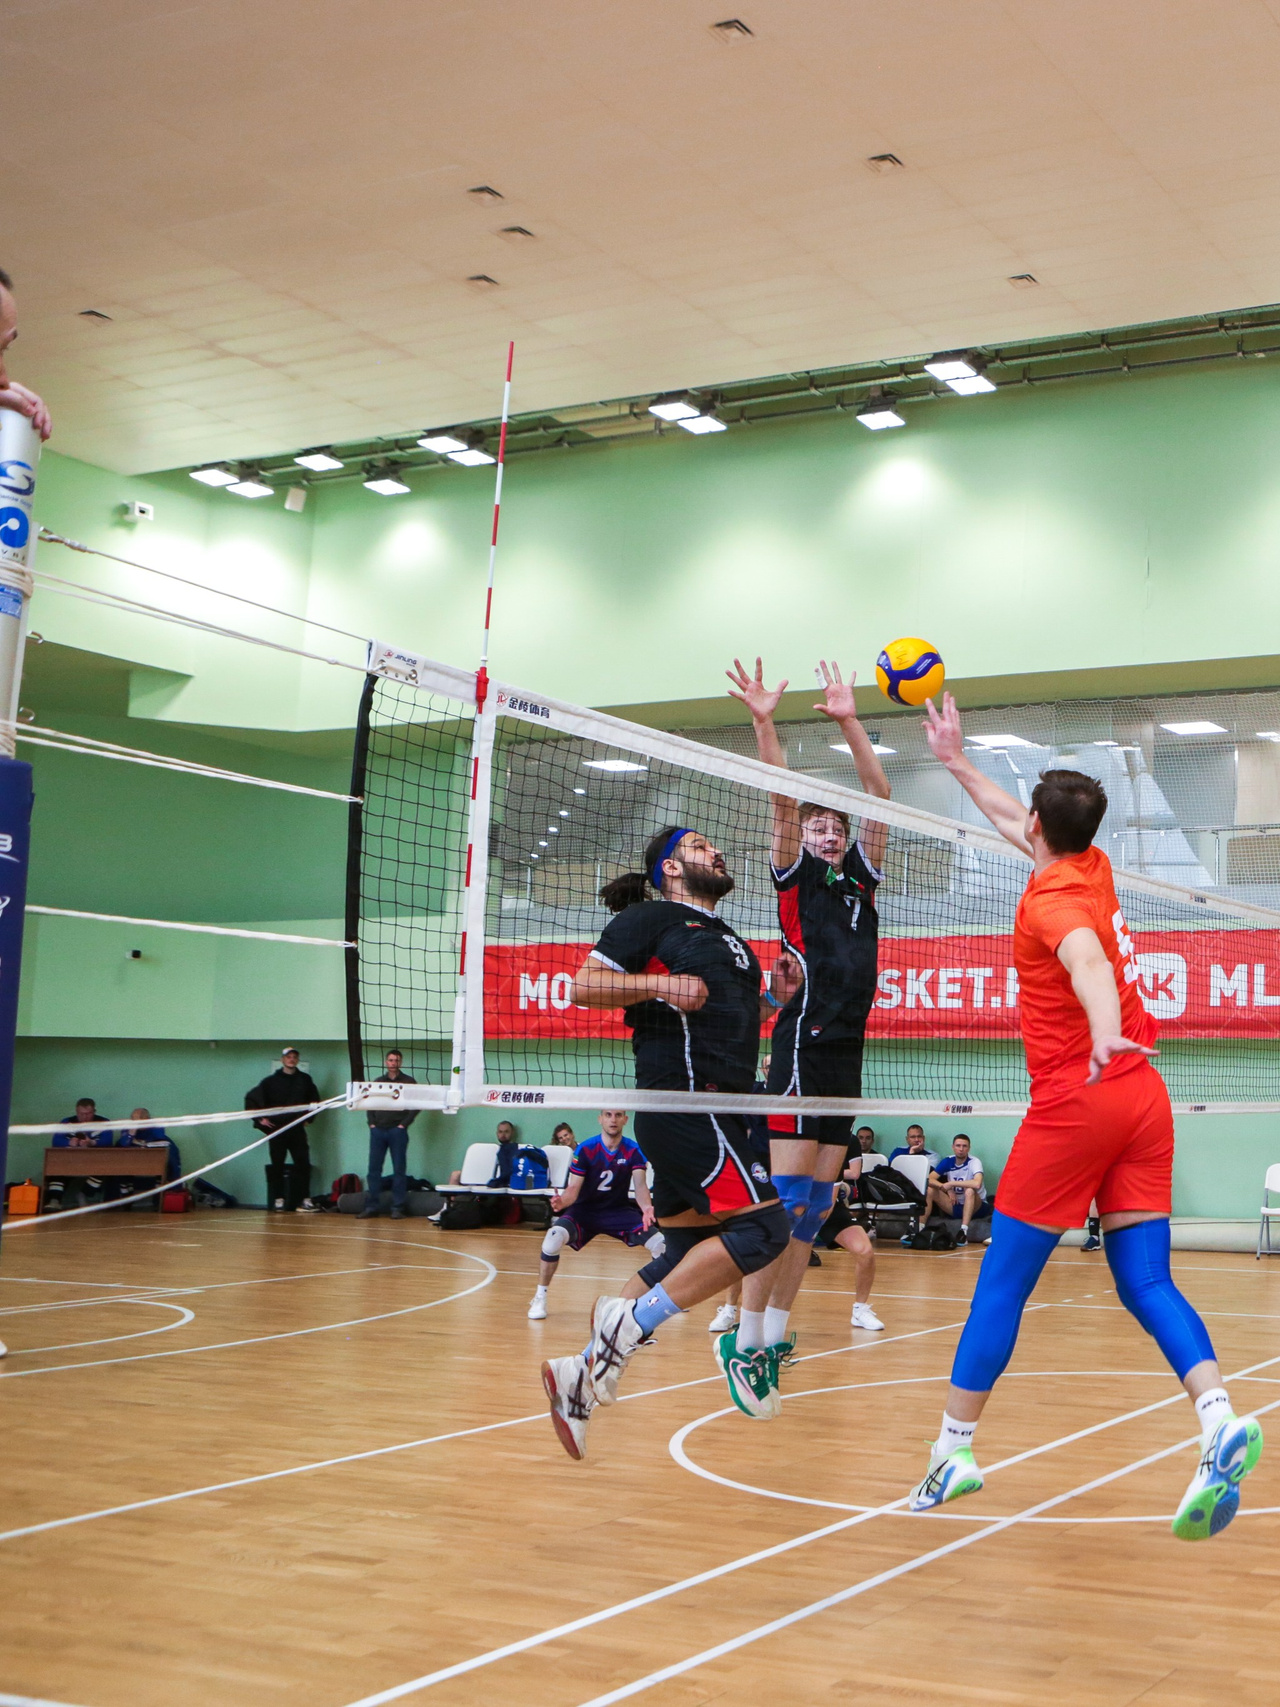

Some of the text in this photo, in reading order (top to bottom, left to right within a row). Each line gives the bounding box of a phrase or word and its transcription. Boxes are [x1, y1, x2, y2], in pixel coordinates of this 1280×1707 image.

[508, 697, 550, 719] 金陵体育
[871, 967, 1021, 1009] SKET.
[596, 1169, 614, 1192] 2
